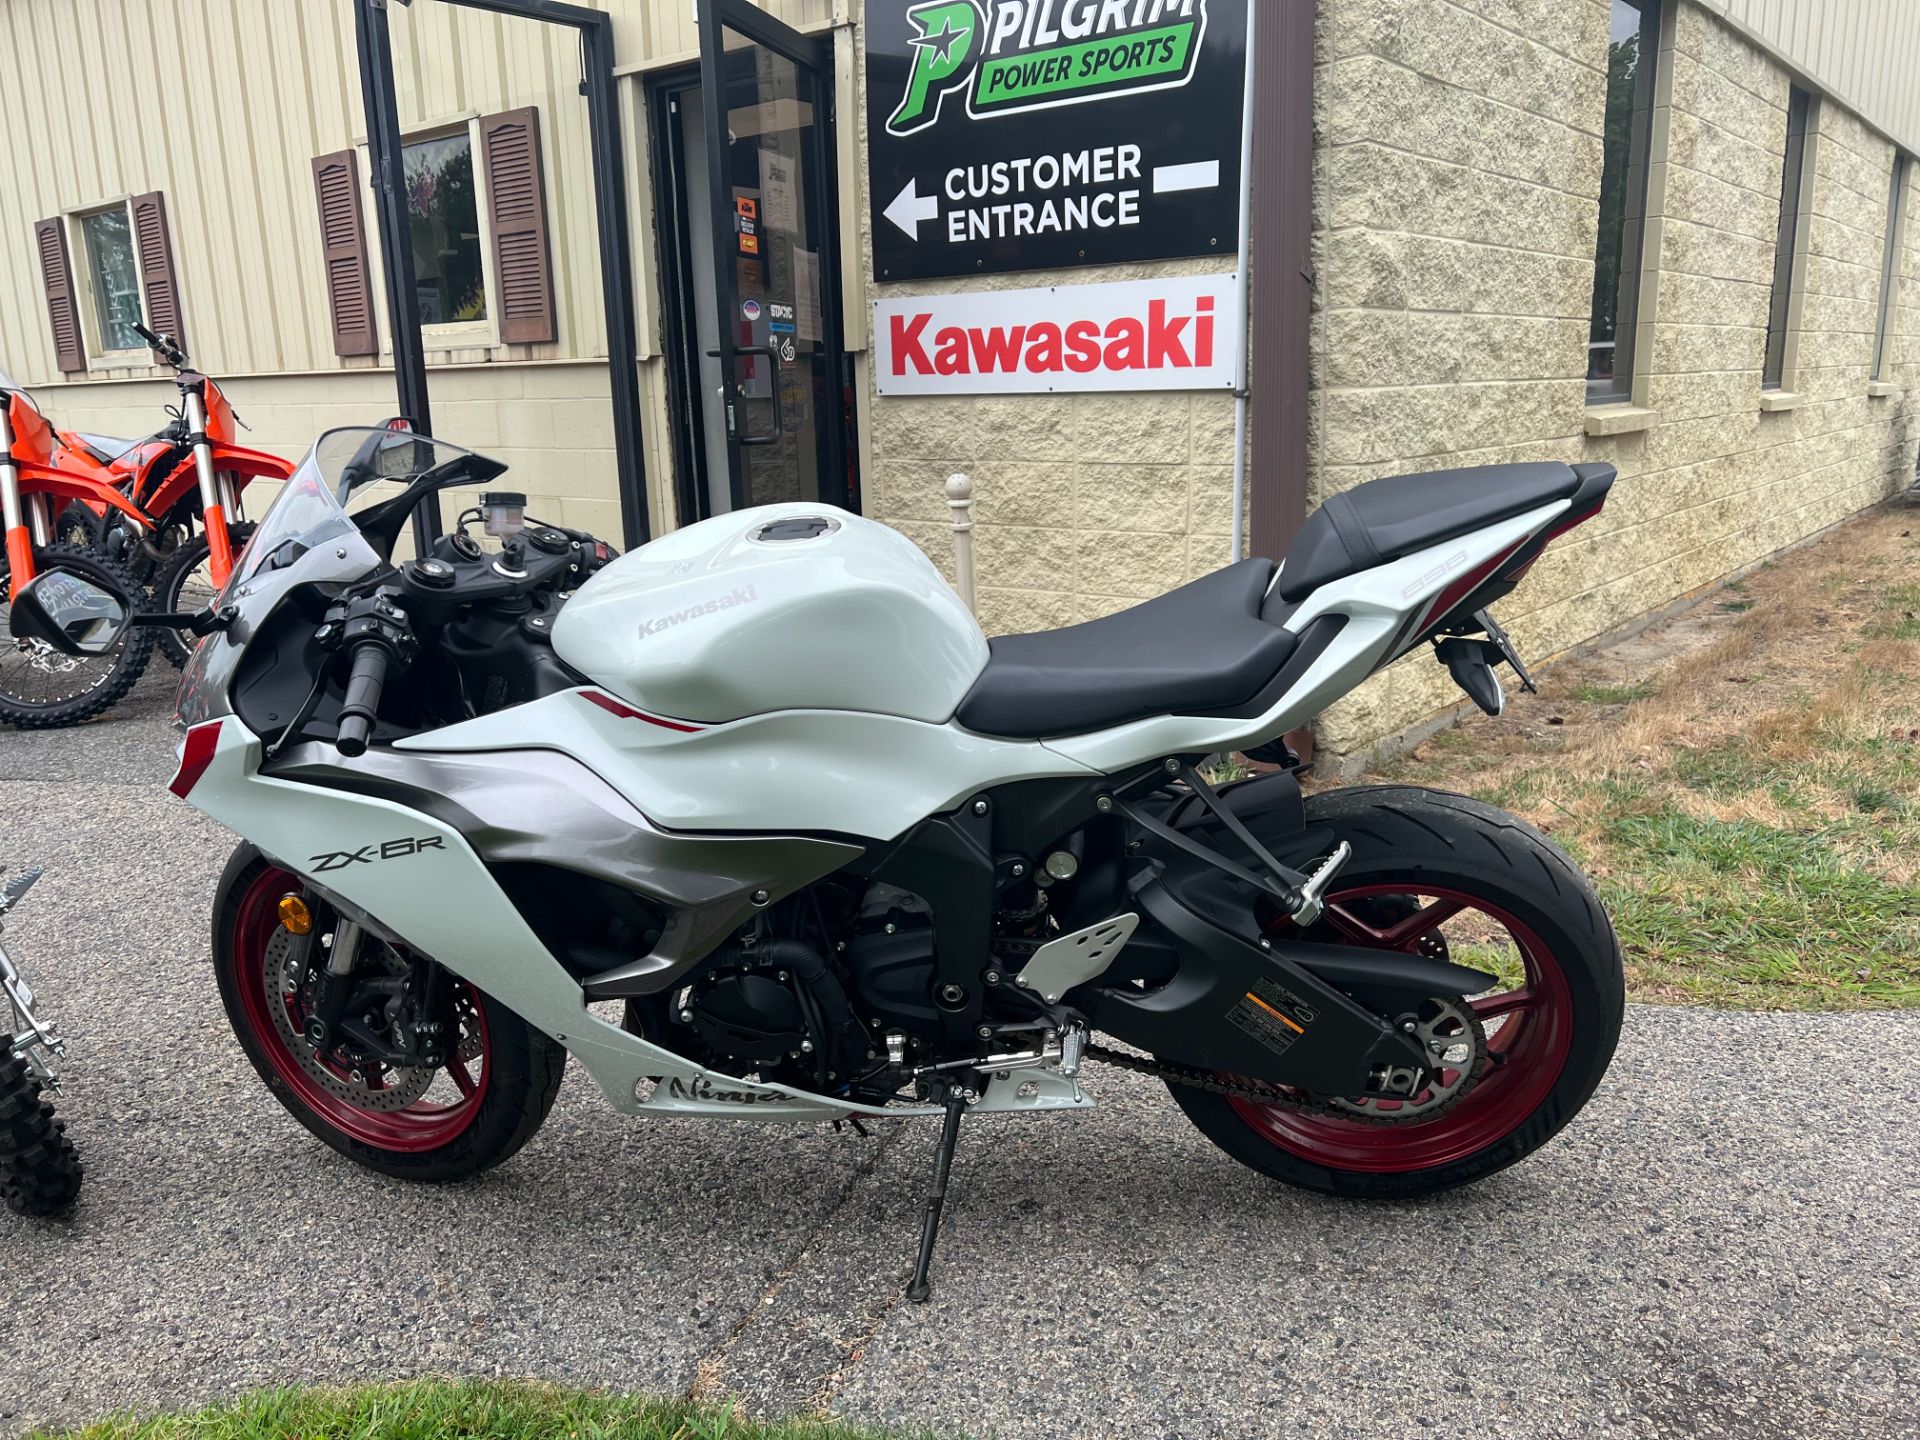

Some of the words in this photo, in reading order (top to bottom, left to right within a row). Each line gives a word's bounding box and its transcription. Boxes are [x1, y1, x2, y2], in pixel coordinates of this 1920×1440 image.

[989, 53, 1073, 93] POWER
[1079, 35, 1177, 78] SPORTS
[945, 144, 1142, 200] CUSTOMER
[948, 190, 1140, 242] ENTRANCE
[890, 296, 1214, 376] Kawasaki
[638, 584, 757, 640] Kawasaki
[308, 836, 447, 873] ZX-6R
[669, 1076, 798, 1104] Ninja
